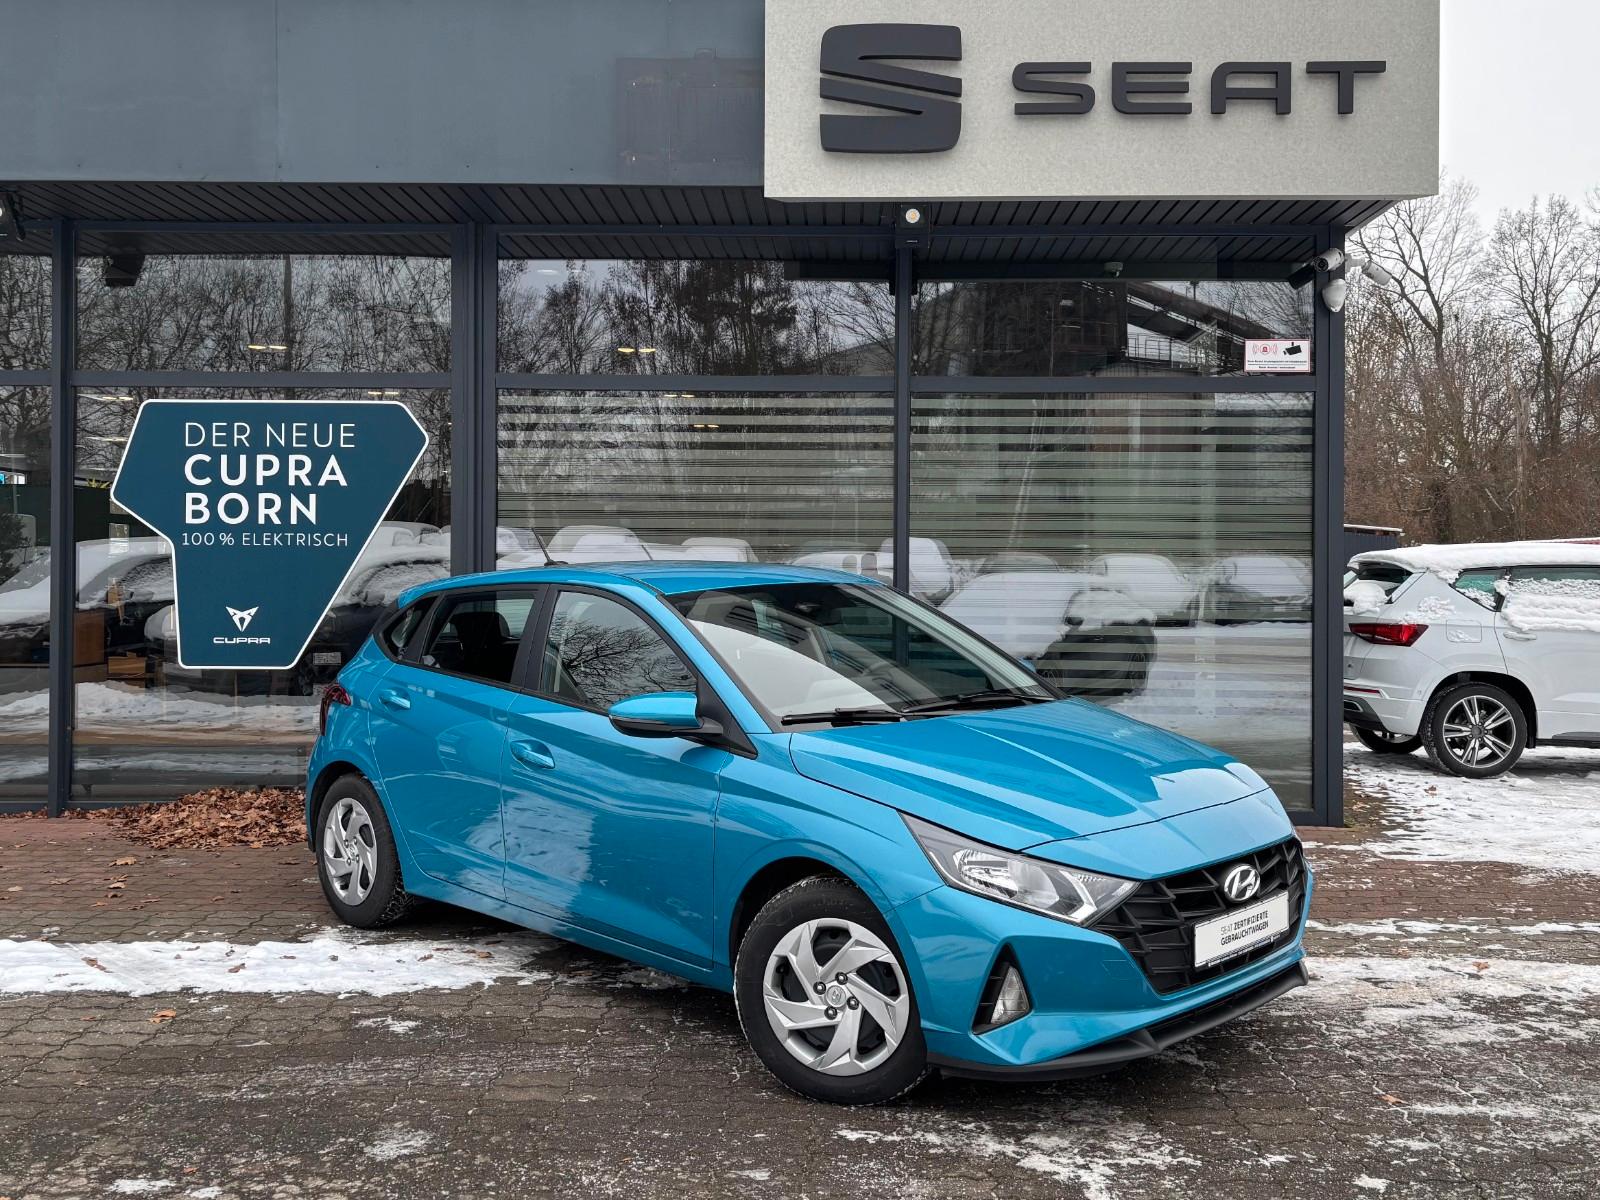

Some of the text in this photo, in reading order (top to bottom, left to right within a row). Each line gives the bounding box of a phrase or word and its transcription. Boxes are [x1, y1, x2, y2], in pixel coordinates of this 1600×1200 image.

[1012, 61, 1387, 116] SEAT
[185, 422, 356, 448] DER NEUE
[184, 453, 348, 487] CUPRA
[185, 492, 317, 525] BORN
[182, 532, 348, 547] 100 % ELEKTRISCH
[1220, 920, 1269, 946] GEBRAUCHTWAGEN
[1233, 910, 1269, 931] ZERTIFIZIERTE
